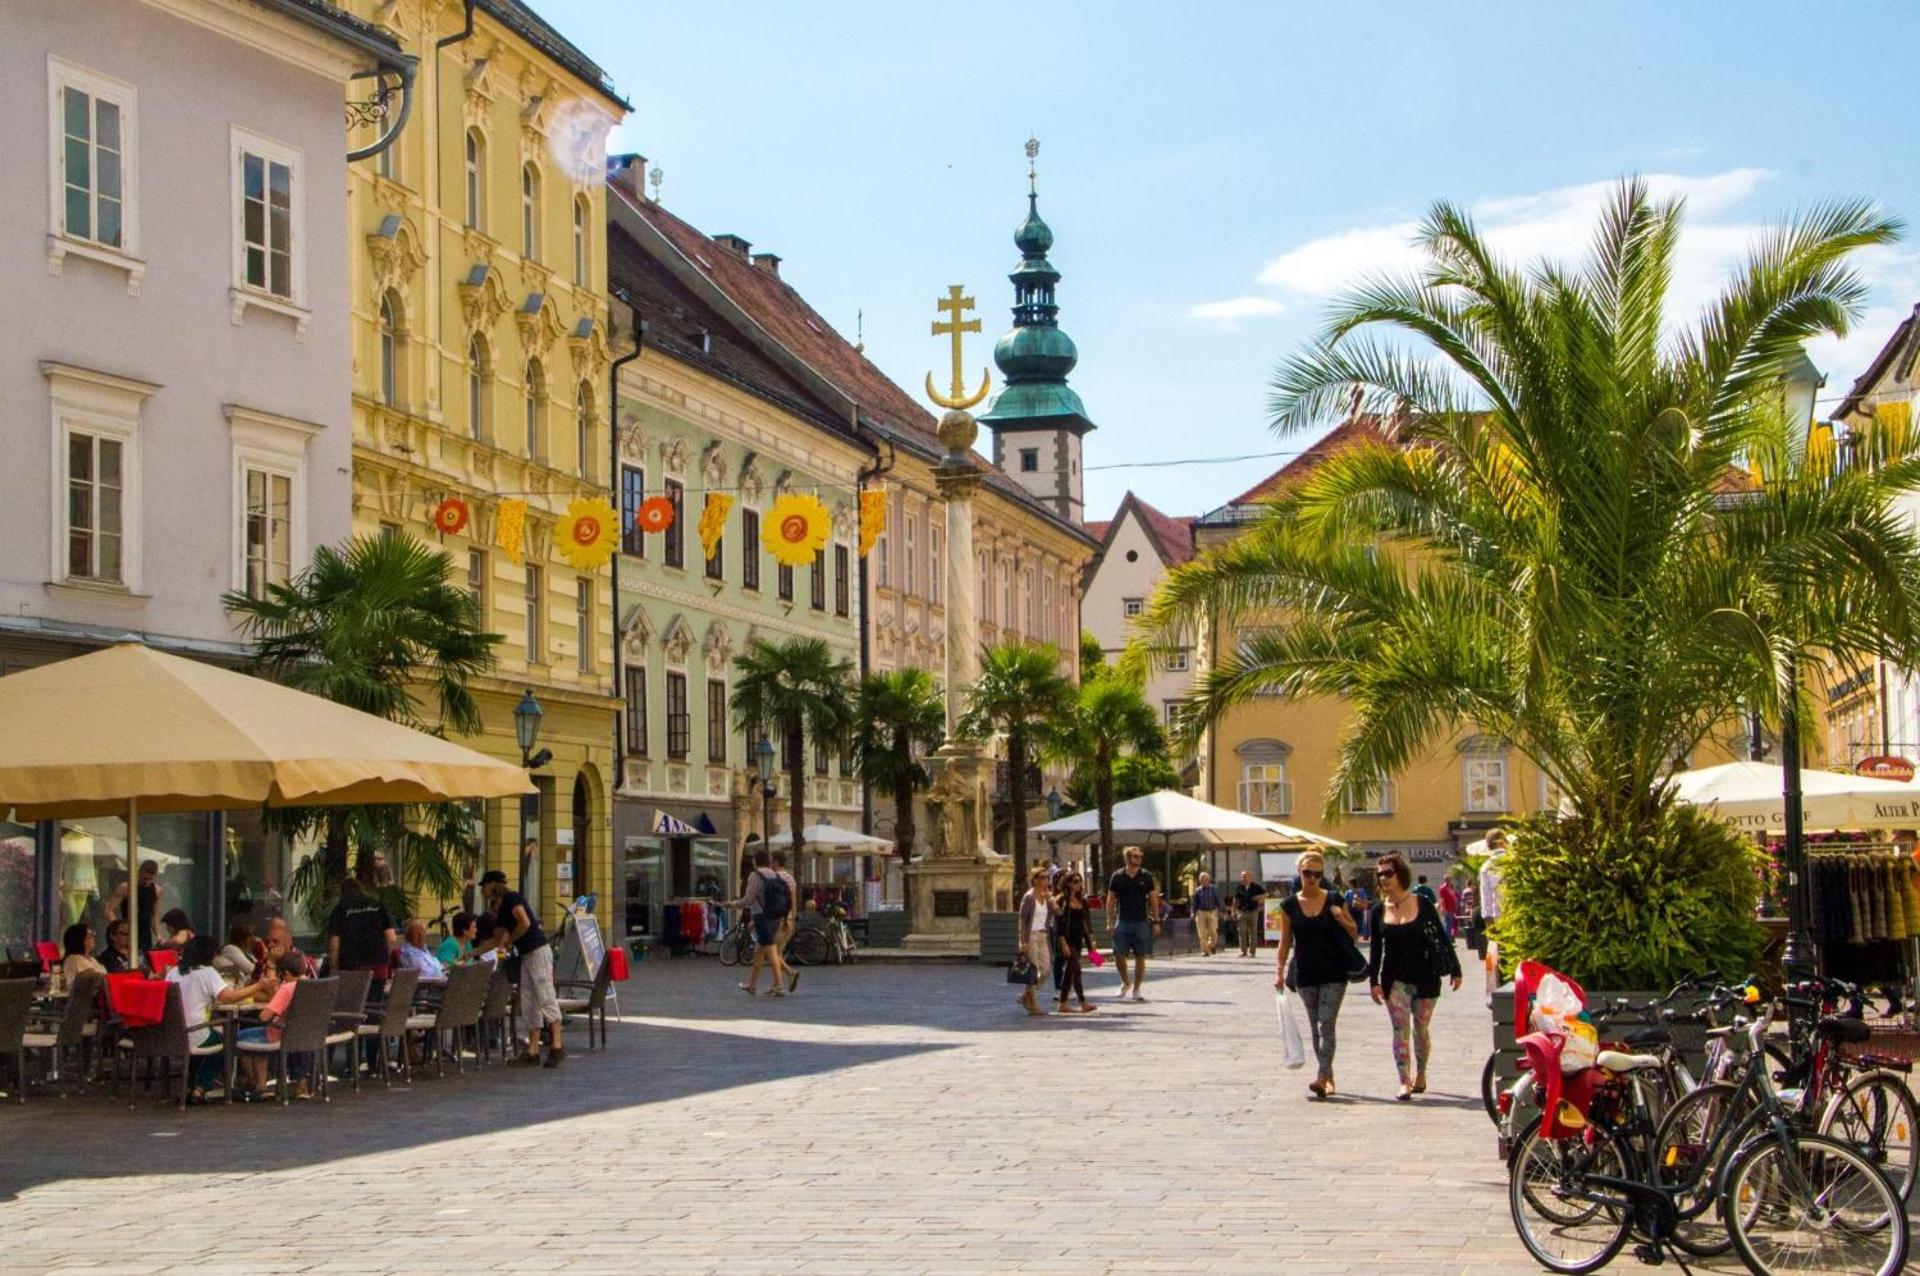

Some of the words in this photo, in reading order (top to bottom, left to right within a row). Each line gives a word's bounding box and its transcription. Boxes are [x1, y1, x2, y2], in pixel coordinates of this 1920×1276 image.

[1875, 802, 1909, 818] ALTER
[1726, 814, 1766, 827] OTTO
[1771, 811, 1811, 823] GF
